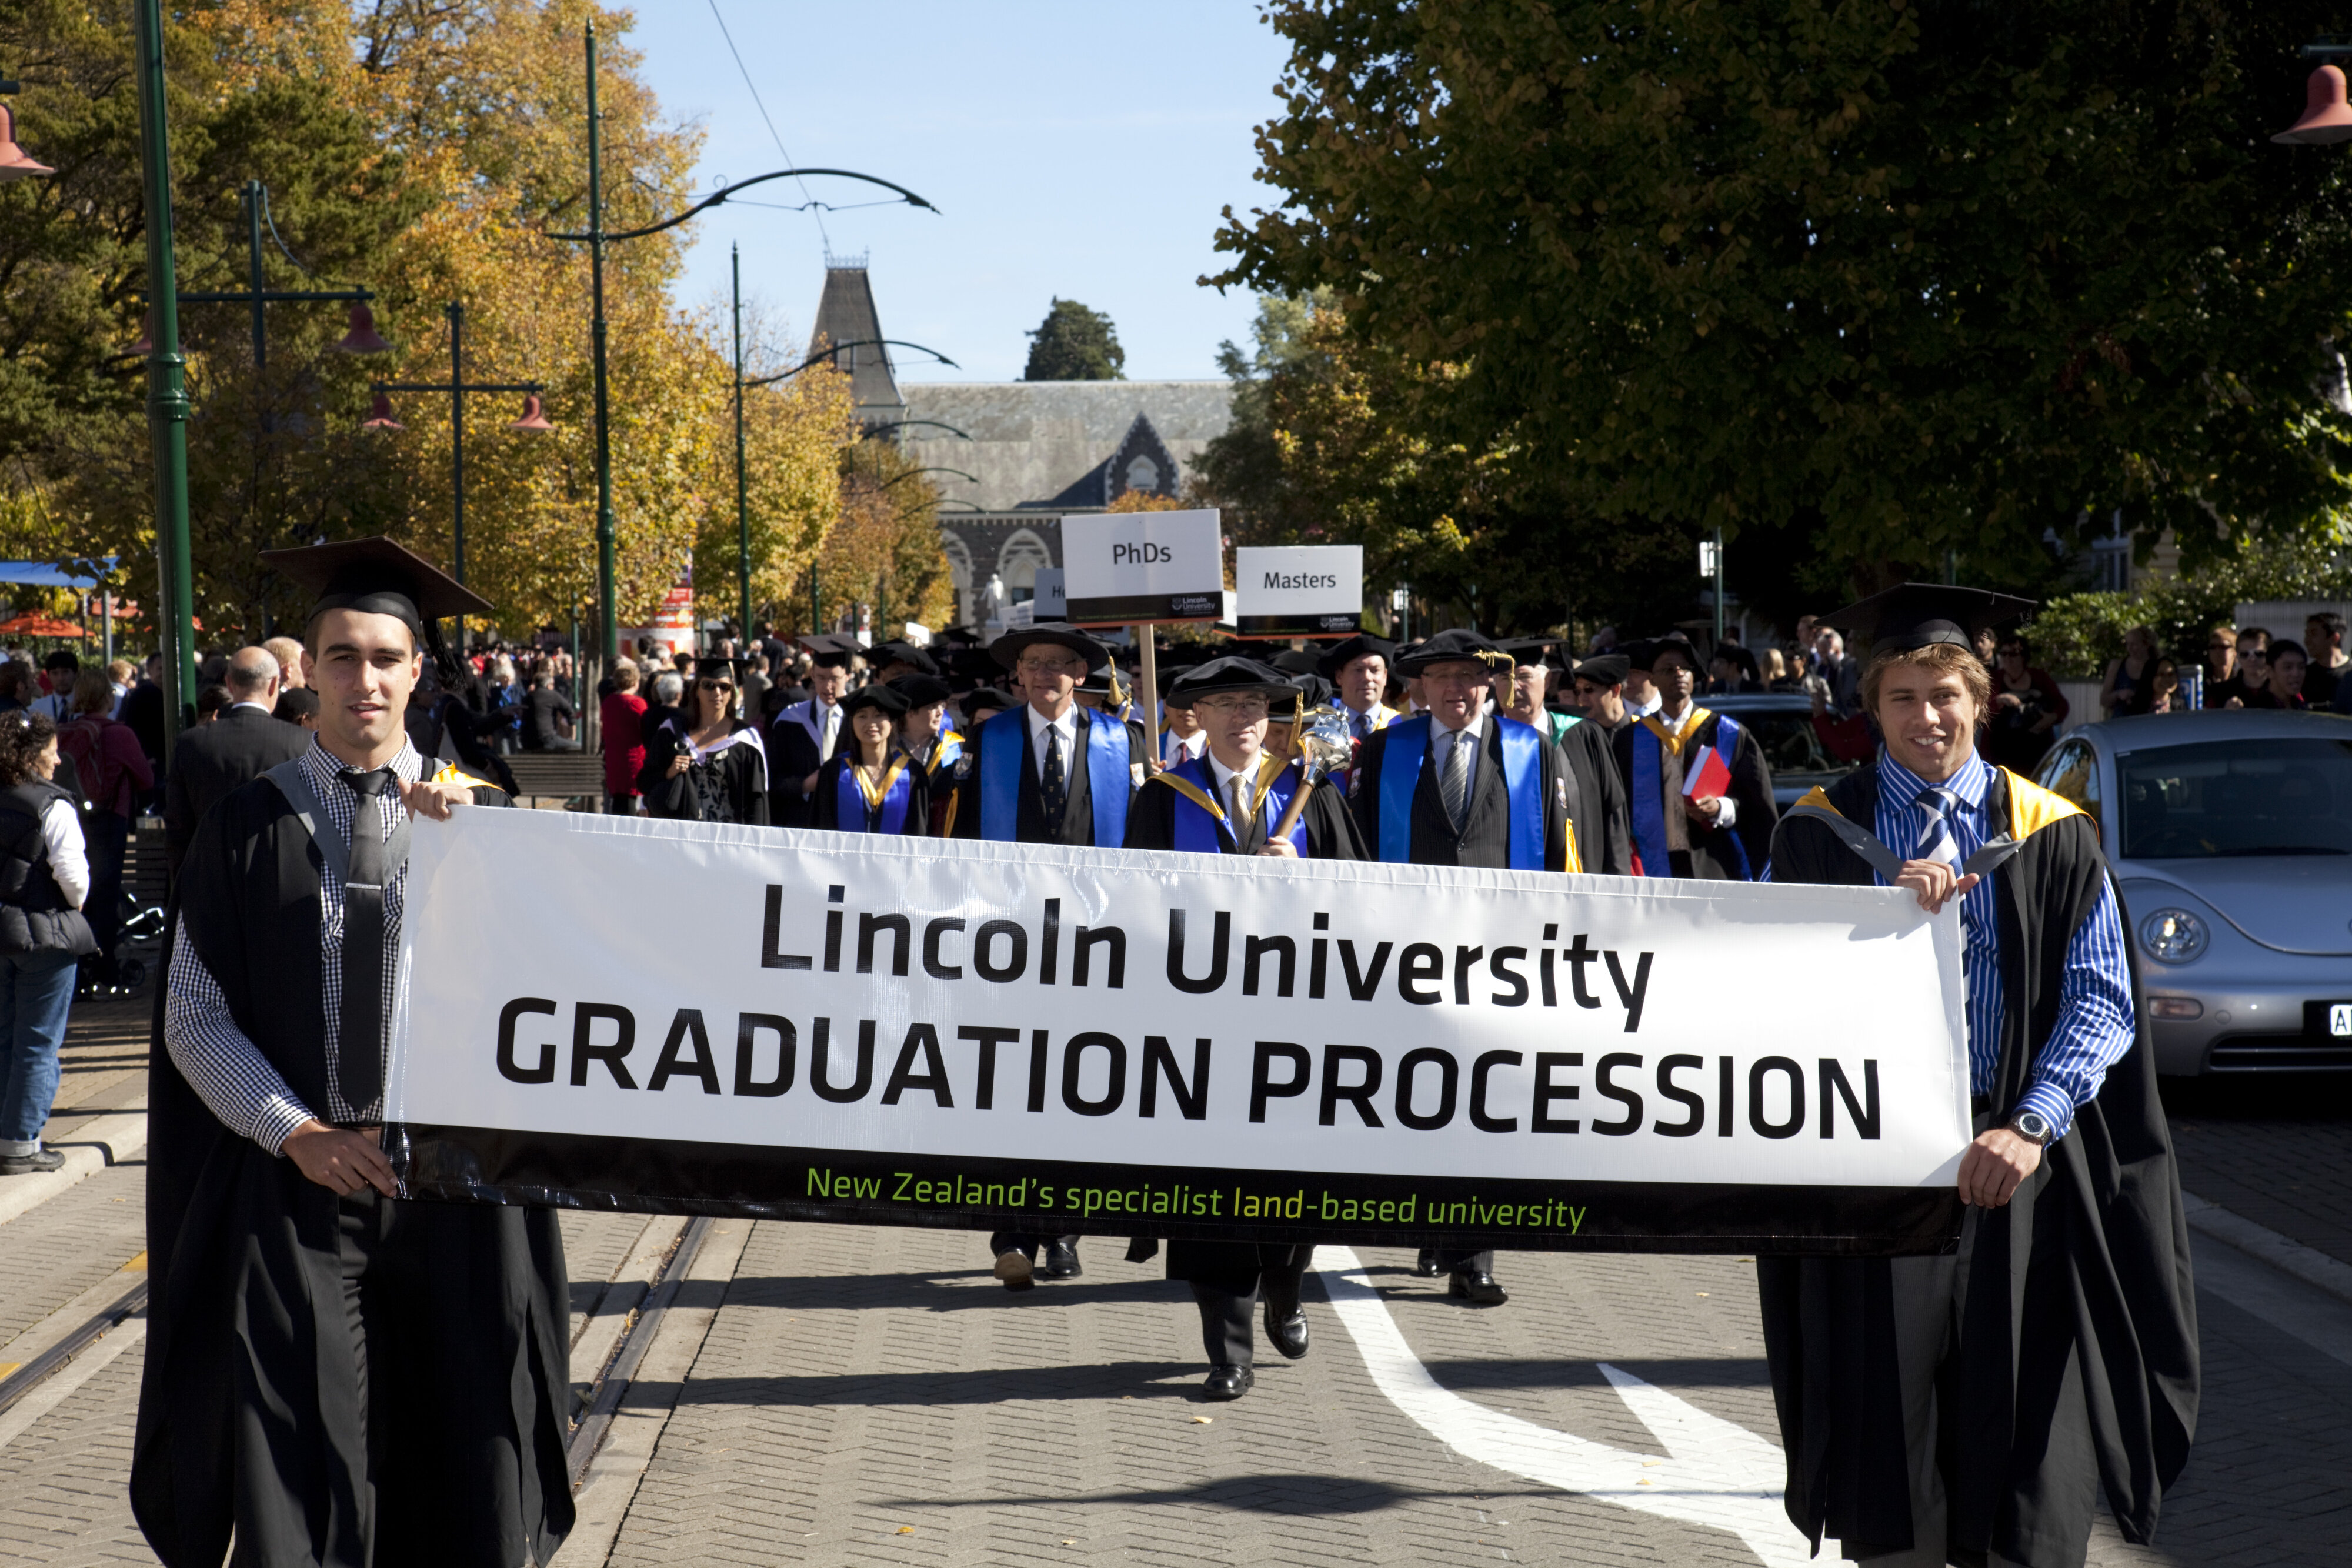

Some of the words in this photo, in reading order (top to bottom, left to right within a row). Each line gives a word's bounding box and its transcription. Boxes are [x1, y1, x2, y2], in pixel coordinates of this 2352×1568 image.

[1113, 542, 1172, 565] PhDs
[1264, 572, 1336, 589] Masters
[760, 884, 1127, 990] Lincoln
[1166, 908, 1654, 1033] University
[2334, 1009, 2352, 1032] A
[496, 996, 1212, 1122] GRADUATION
[1249, 1040, 1881, 1140] PROCESSION
[807, 1167, 882, 1200] New
[892, 1172, 1054, 1209] Zealand's
[1066, 1183, 1223, 1219] specialist
[1233, 1186, 1417, 1223] land-based
[1427, 1195, 1587, 1235] university
